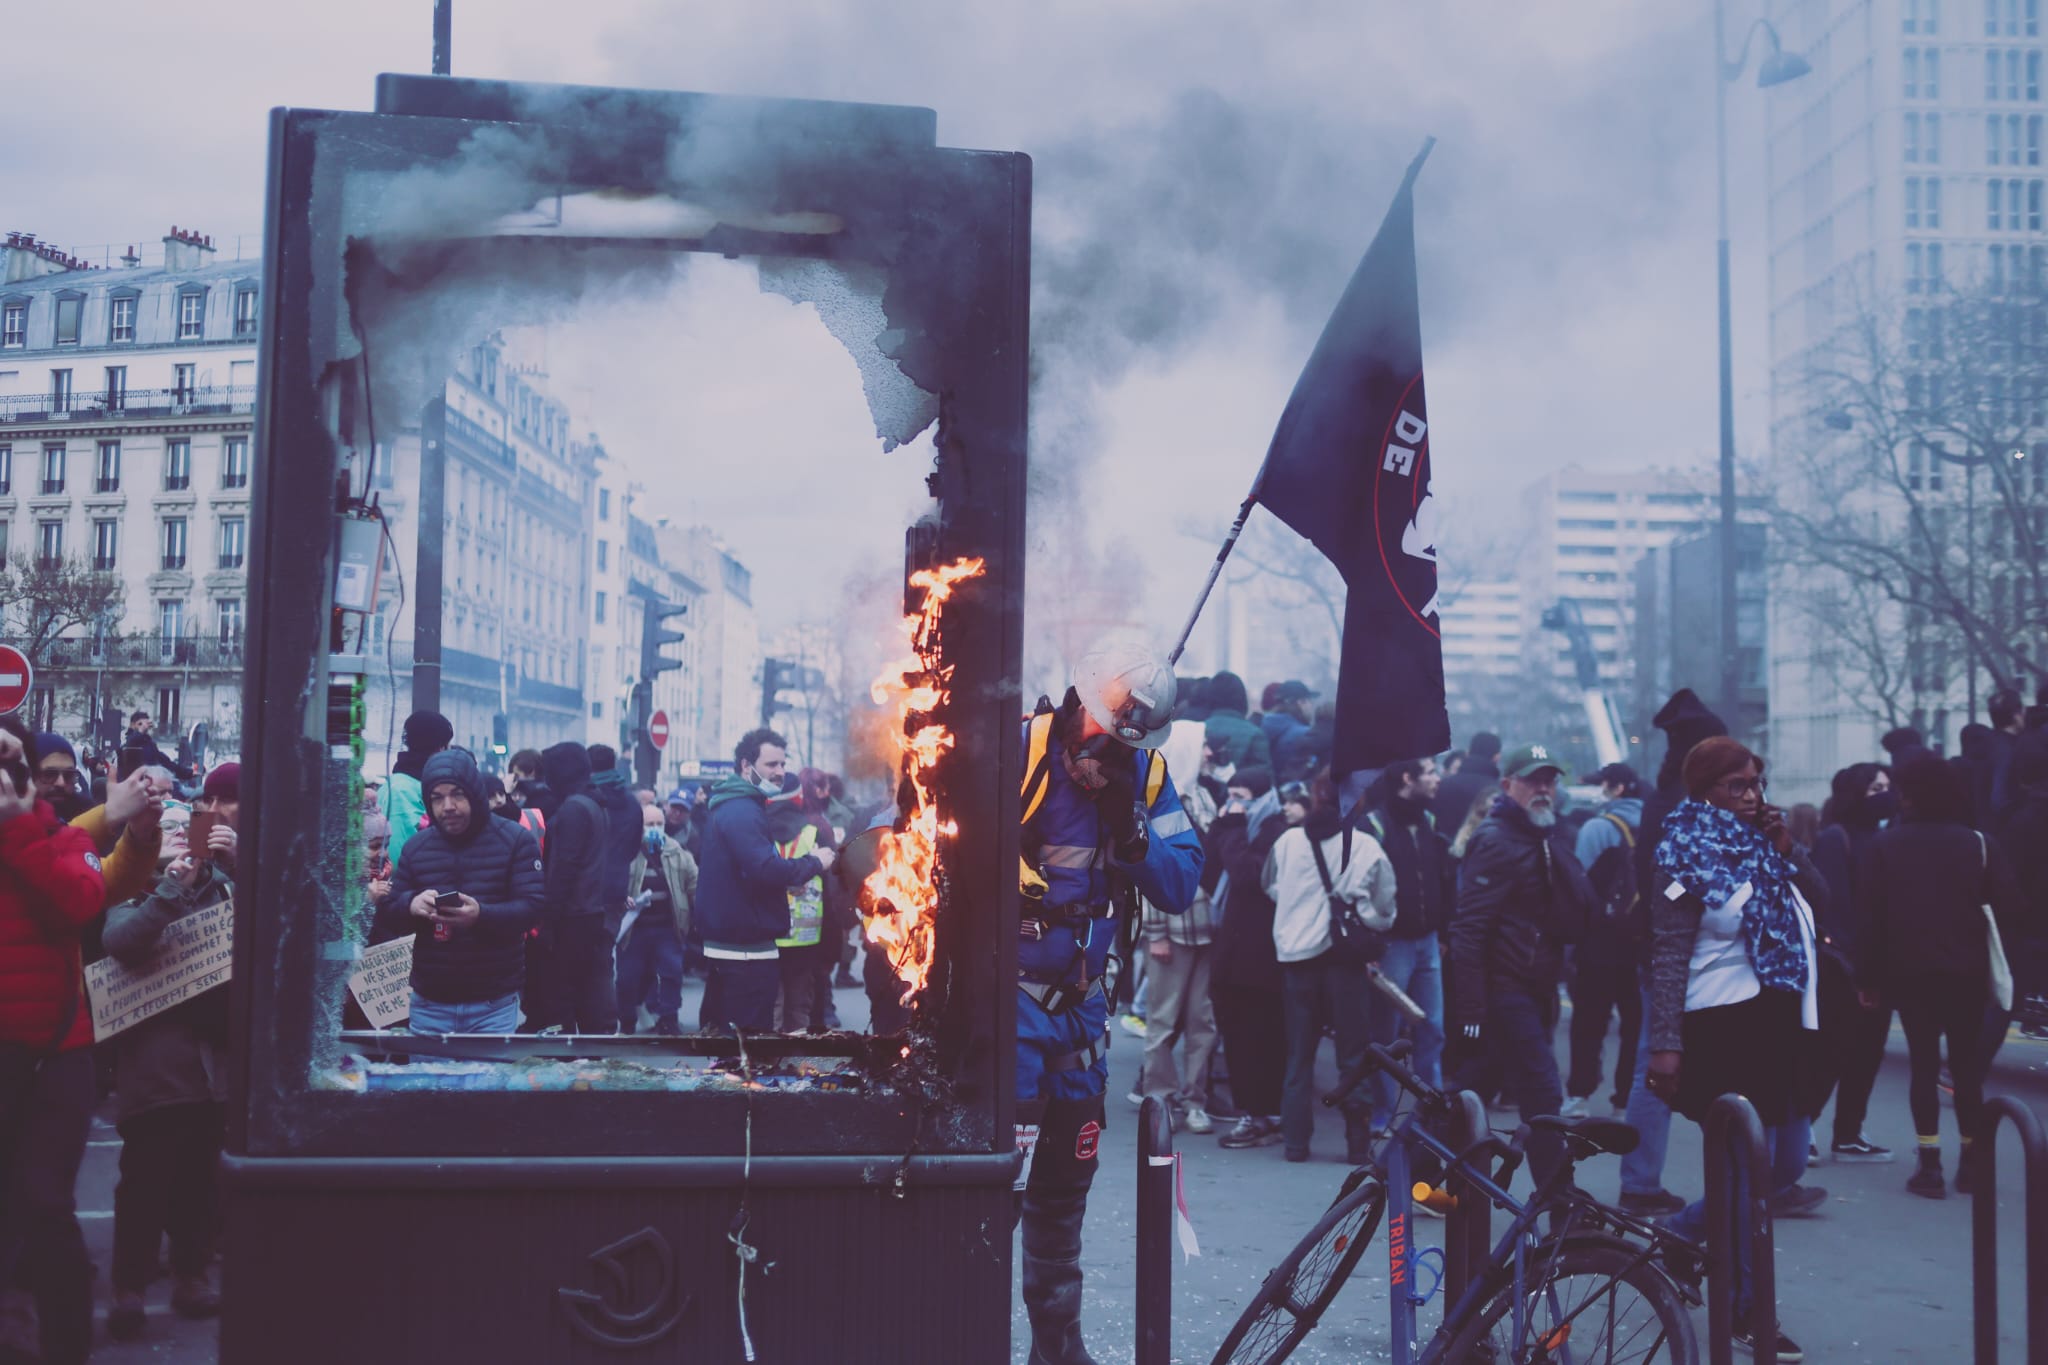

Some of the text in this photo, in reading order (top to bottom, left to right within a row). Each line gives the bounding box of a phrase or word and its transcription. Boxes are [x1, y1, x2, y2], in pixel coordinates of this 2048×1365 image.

[1383, 410, 1427, 477] DE
[179, 935, 221, 962] SOMMET
[376, 1000, 393, 1017] NE
[1390, 1213, 1405, 1286] TRIBAN
